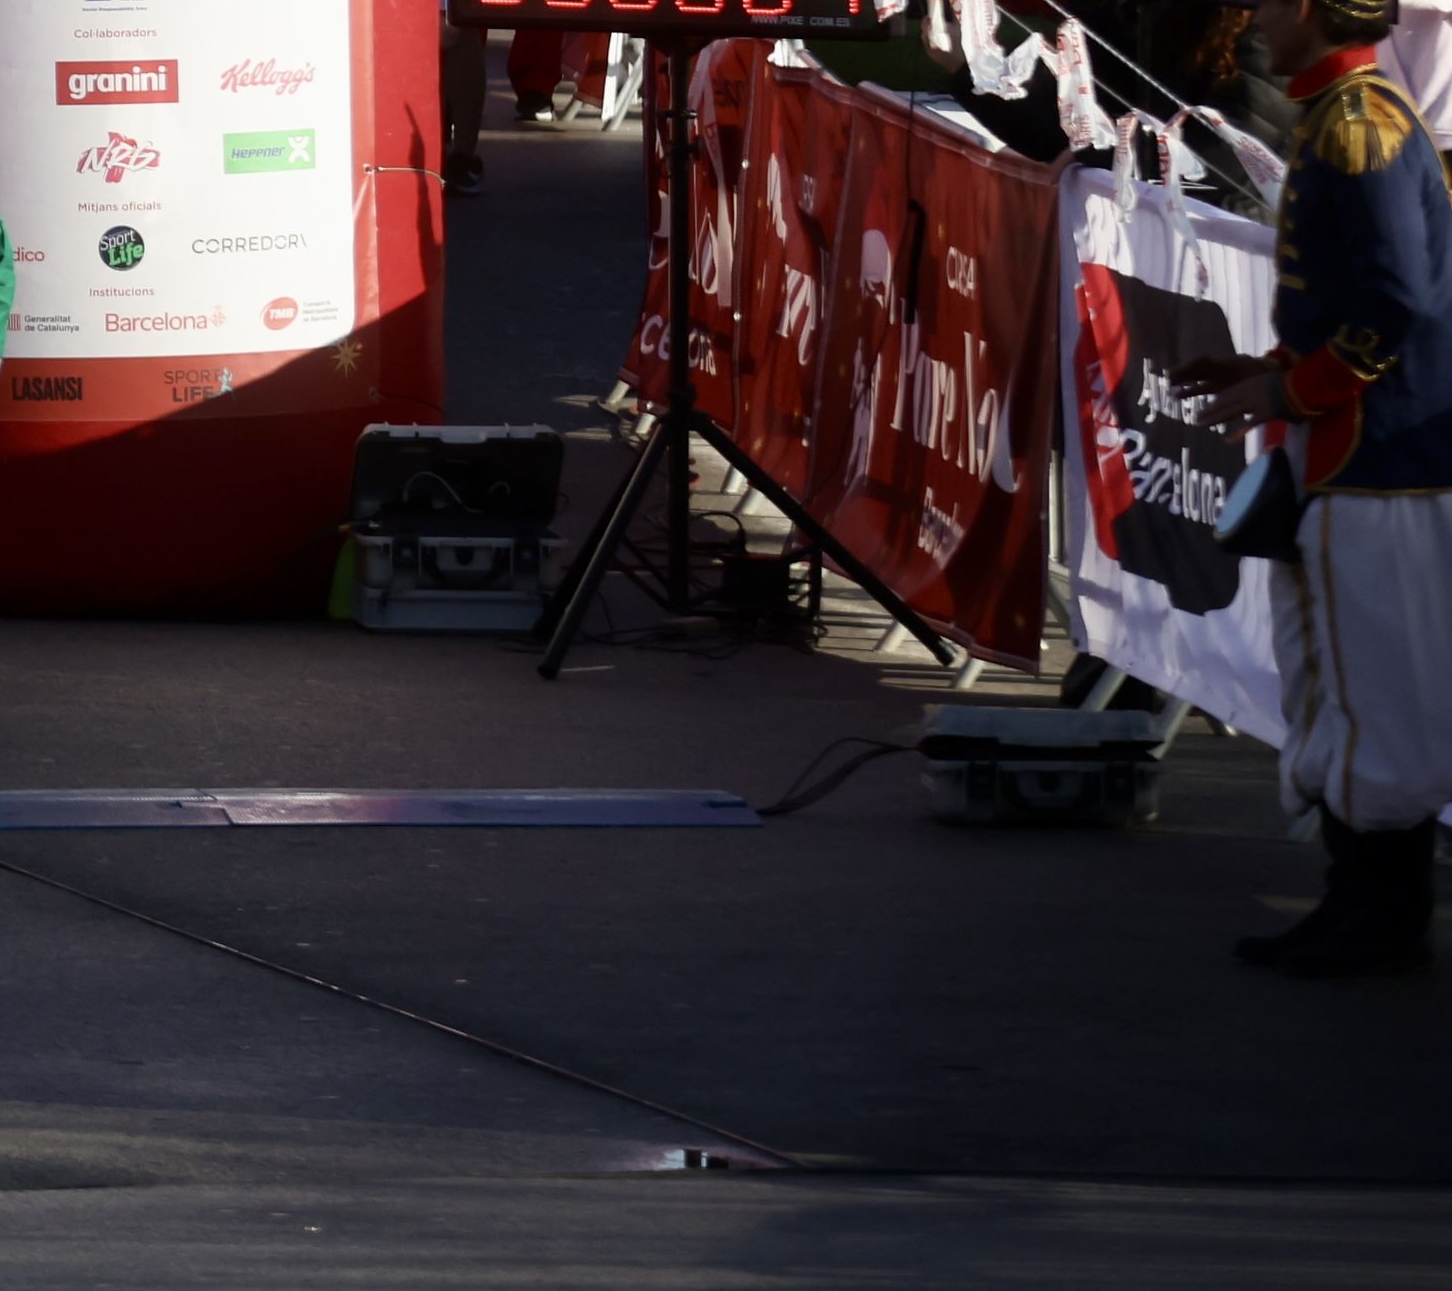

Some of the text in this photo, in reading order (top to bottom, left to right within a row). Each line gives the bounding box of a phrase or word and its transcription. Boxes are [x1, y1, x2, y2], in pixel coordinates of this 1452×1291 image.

[68, 66, 167, 100] granini
[220, 58, 316, 95] Kellogg's
[78, 202, 161, 213] Mitjans oficials
[100, 230, 135, 251] Sport
[109, 243, 144, 266] Life
[89, 287, 154, 297] Institucions
[105, 313, 207, 332] Barcelona
[268, 307, 295, 319] TMB
[43, 324, 79, 333] Catalunya
[12, 377, 83, 401] LASANSI
